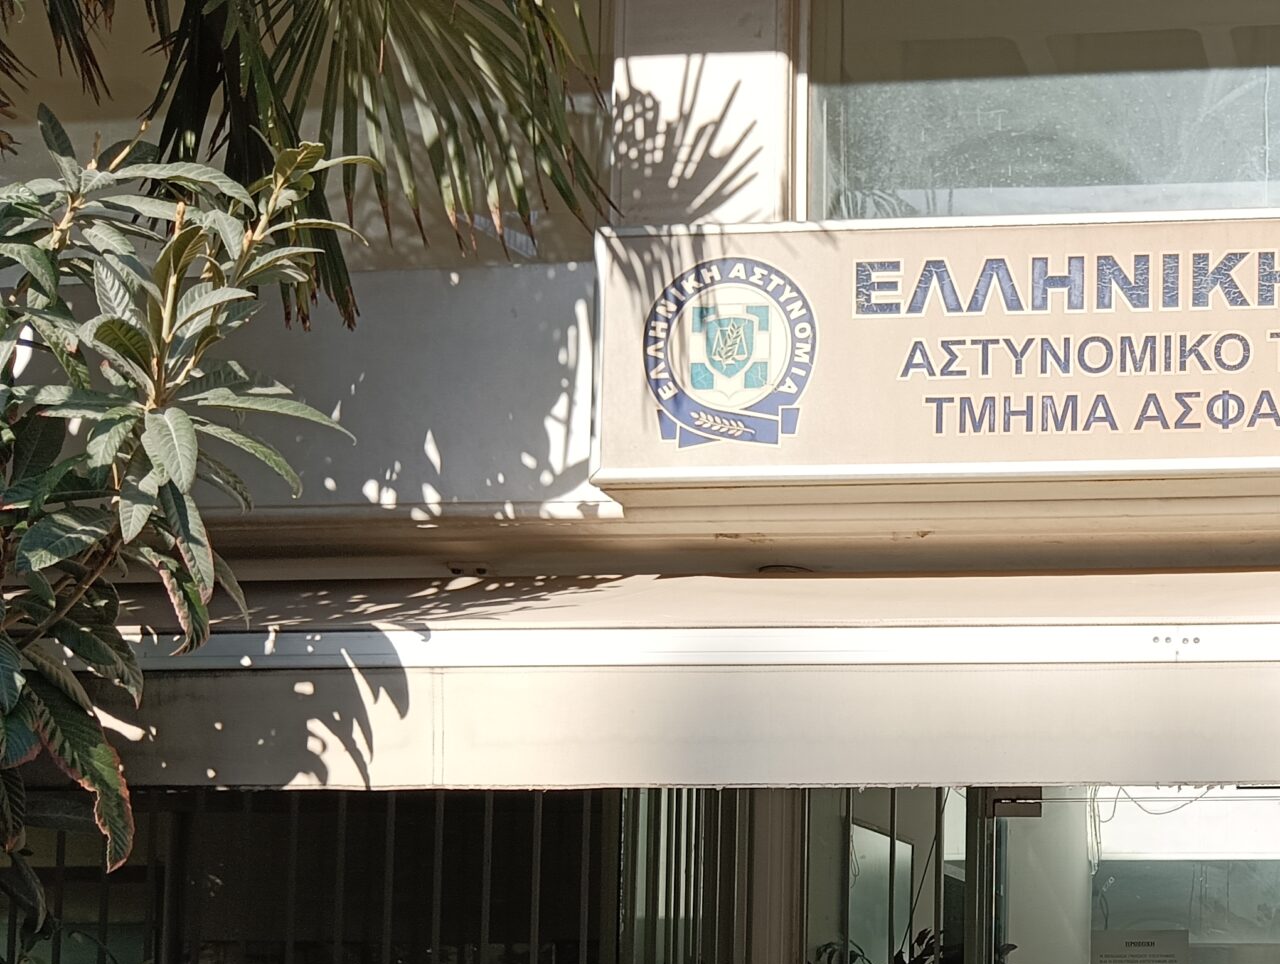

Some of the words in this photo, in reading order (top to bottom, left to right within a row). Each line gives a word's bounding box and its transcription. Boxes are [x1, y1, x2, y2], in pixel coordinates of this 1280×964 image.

[646, 264, 722, 401] ΕΛΛΗΝΙΚΗ
[728, 262, 812, 396] ΑΣΤΥΝΟΜΙΑ
[900, 332, 1252, 378] ΑΣΤΥΝΟΜΙΚΟ
[924, 394, 1119, 434] ΤΜΗΜΑ
